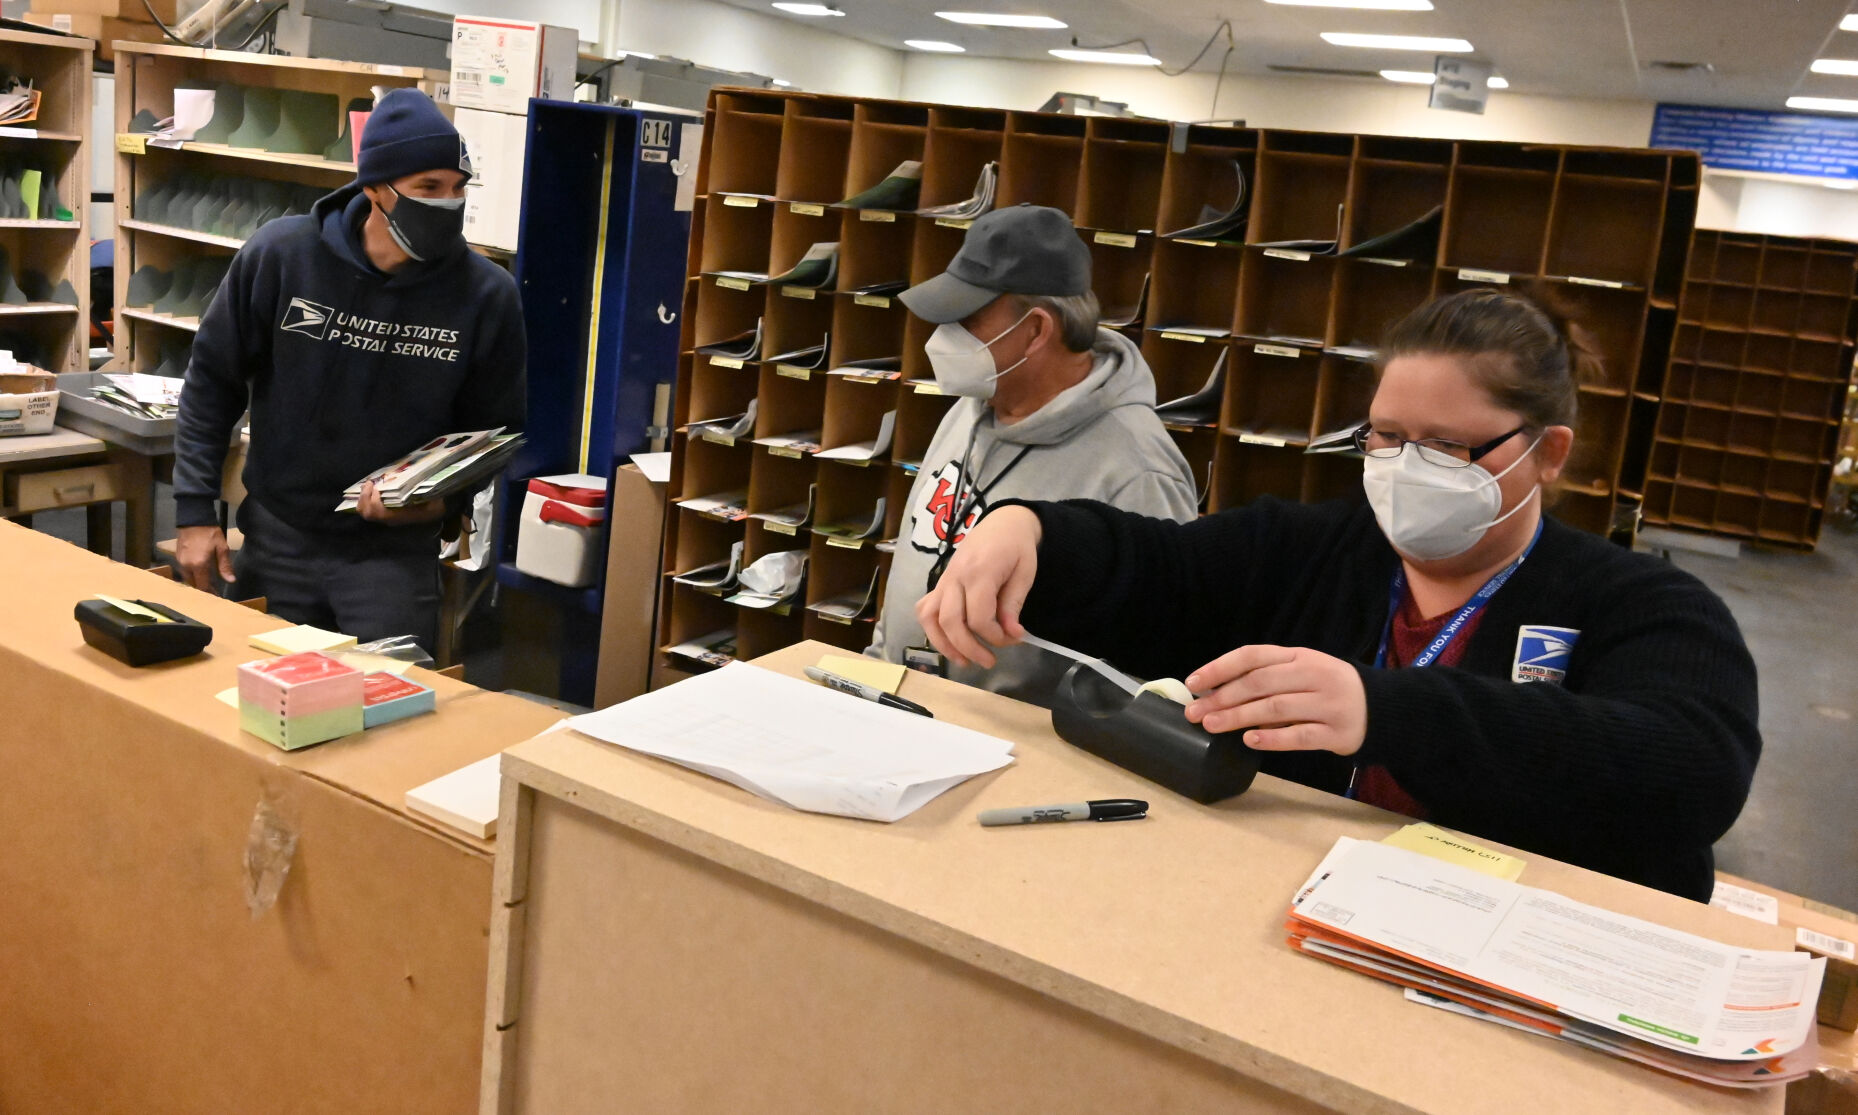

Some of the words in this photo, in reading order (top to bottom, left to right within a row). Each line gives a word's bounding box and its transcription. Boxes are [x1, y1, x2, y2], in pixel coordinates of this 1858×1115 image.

[336, 312, 400, 335] UNITED
[401, 325, 460, 343] STATES
[328, 329, 387, 352] POSTAL
[391, 342, 460, 362] SERVICE
[1446, 606, 1476, 634] THANK
[1430, 634, 1450, 652] YOU
